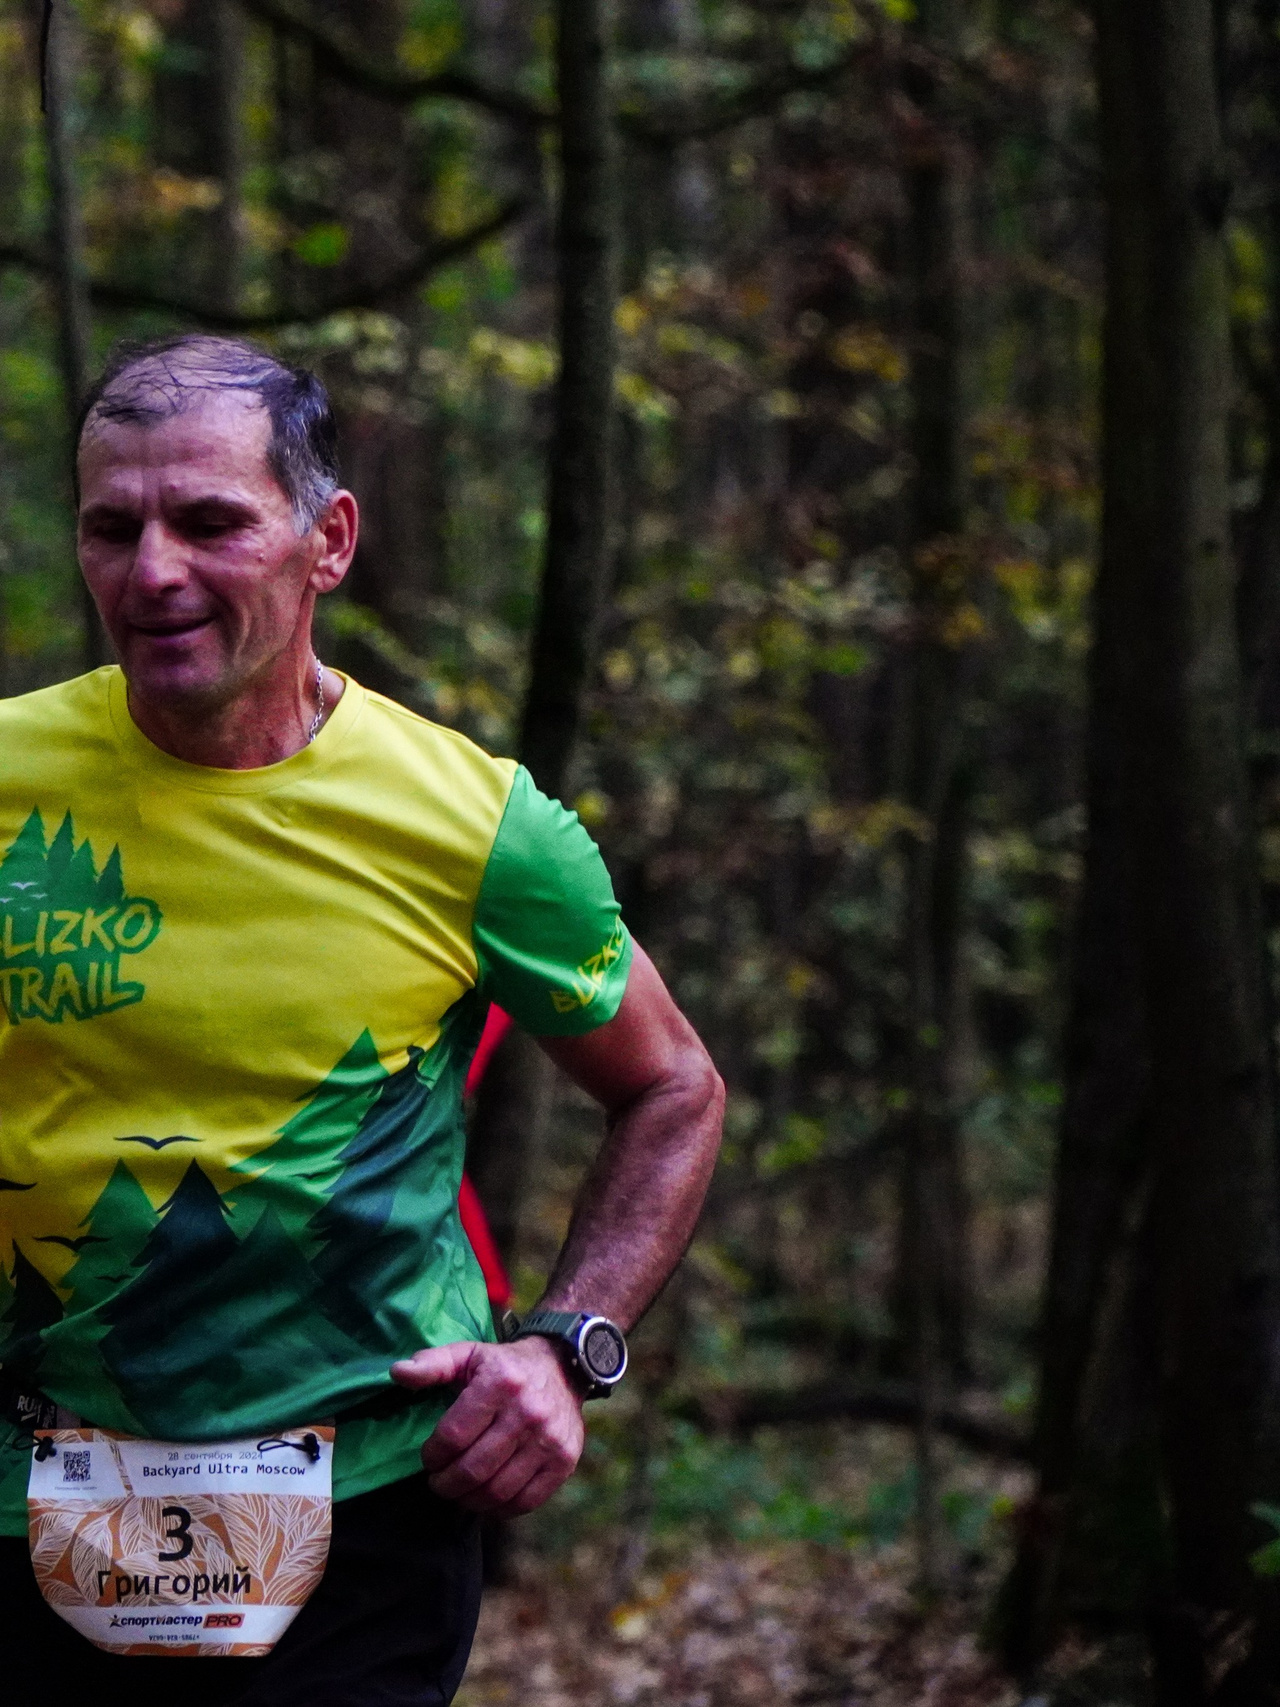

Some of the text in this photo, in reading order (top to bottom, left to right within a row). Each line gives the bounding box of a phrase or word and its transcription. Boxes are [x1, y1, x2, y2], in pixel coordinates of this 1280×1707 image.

[167, 1451, 179, 1461] 28
[184, 1450, 232, 1462] сентября
[143, 1463, 306, 1478] Backyard Ultra Moscow
[157, 1506, 194, 1563] 3
[97, 1565, 251, 1602] Григорий
[204, 1614, 243, 1627] PRO
